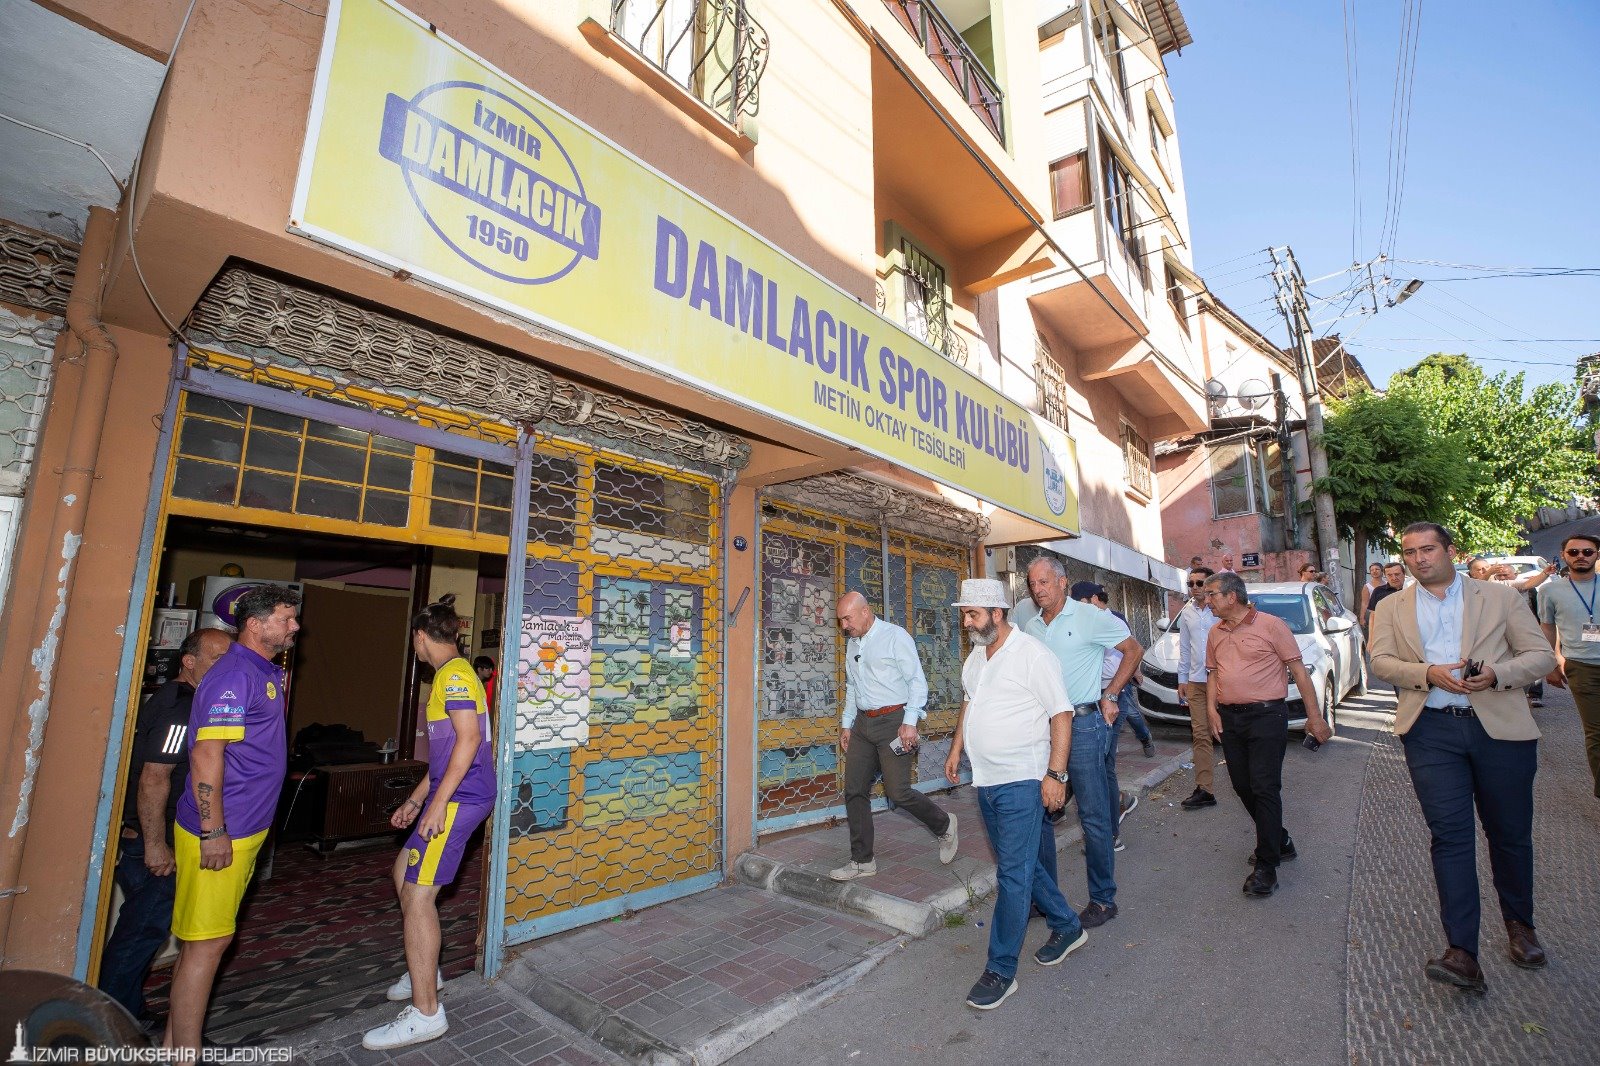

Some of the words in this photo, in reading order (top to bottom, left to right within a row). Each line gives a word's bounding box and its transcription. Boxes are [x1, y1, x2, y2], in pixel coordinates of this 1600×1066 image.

[474, 100, 541, 161] İZMİR
[401, 110, 586, 245] DAMLACIK
[465, 214, 529, 262] 1950
[654, 215, 869, 393] DAMLACIK
[879, 346, 949, 433] SPOR
[955, 389, 1030, 474] KULÜBÜ
[813, 380, 861, 422] METİN
[864, 403, 908, 443] OKTAY
[910, 426, 966, 470] TESİSLERİ
[521, 619, 579, 632] Damlack'ta
